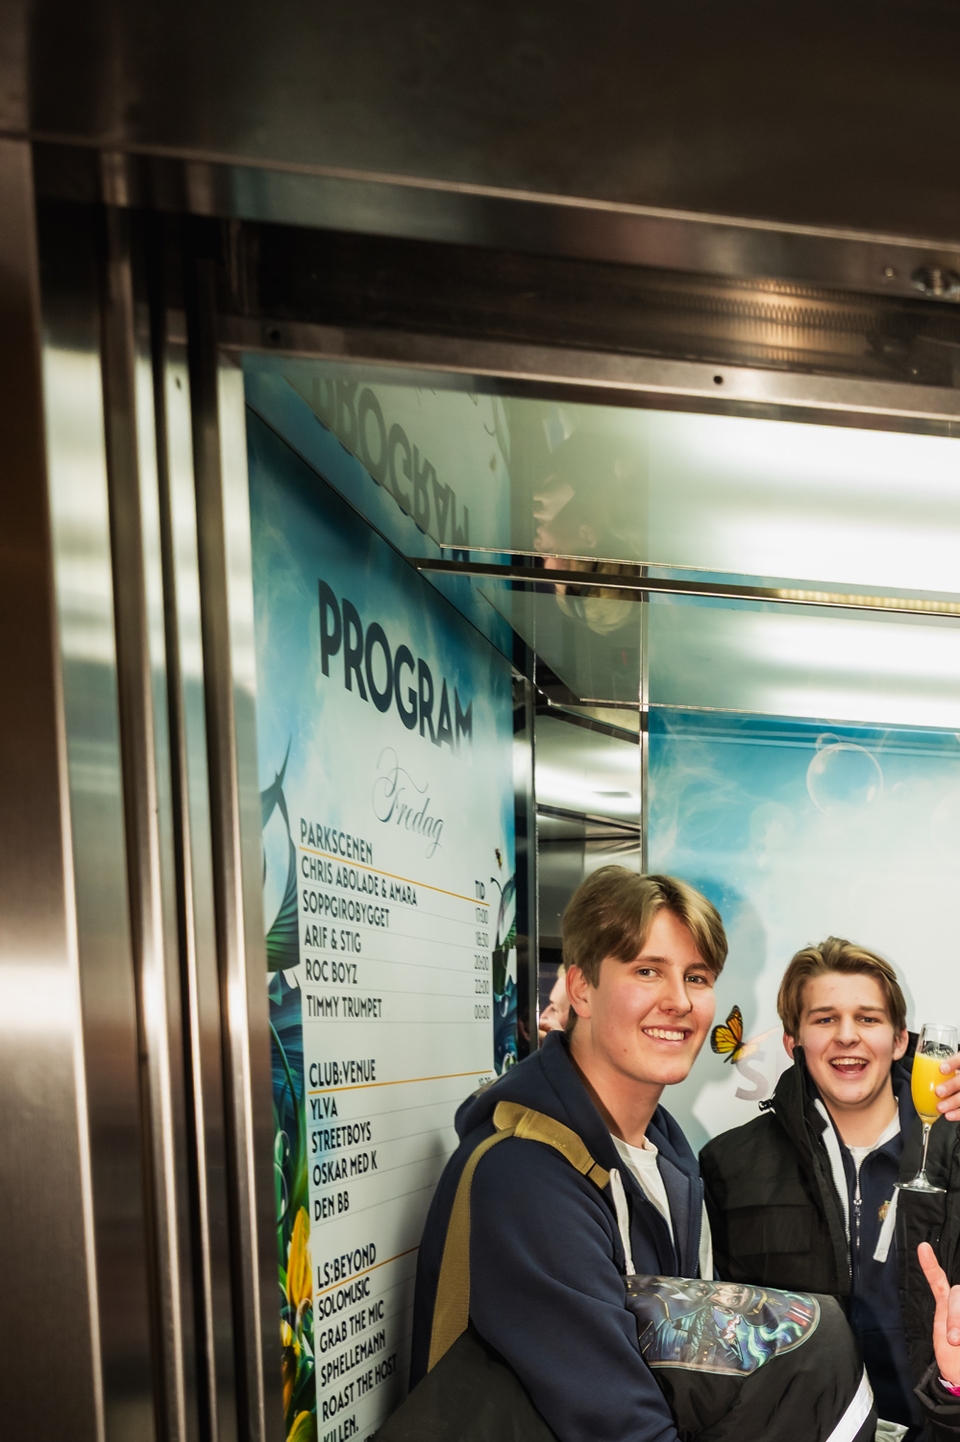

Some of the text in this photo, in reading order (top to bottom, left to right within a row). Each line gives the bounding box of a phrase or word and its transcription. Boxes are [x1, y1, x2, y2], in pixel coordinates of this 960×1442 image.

[318, 578, 474, 758] PROGRAM
[371, 746, 446, 859] Fredag
[300, 817, 373, 865] PARKSCENEN
[301, 855, 418, 906] CHRIS ABOLADE & AMARA
[303, 889, 390, 928] SOPPGIROBYGGET
[304, 924, 361, 953] ARIF & STIG
[305, 958, 358, 984] ROC BOYZ
[306, 995, 383, 1018] TIMMY TRUMPET
[309, 1059, 376, 1088] CLUB:VENUE
[310, 1096, 338, 1121] YLVA
[312, 1121, 372, 1153] STREETBOYS
[312, 1150, 378, 1186] OSKAR MED K
[314, 1191, 350, 1222] DEN BB
[317, 1242, 377, 1290] LS:BEYOND
[318, 1277, 371, 1321] SOLOMUSIC
[319, 1300, 385, 1354] GRAB THE MIC
[321, 1329, 386, 1388] SPHELLEMANN
[322, 1353, 398, 1422] ROAST THE HOST
